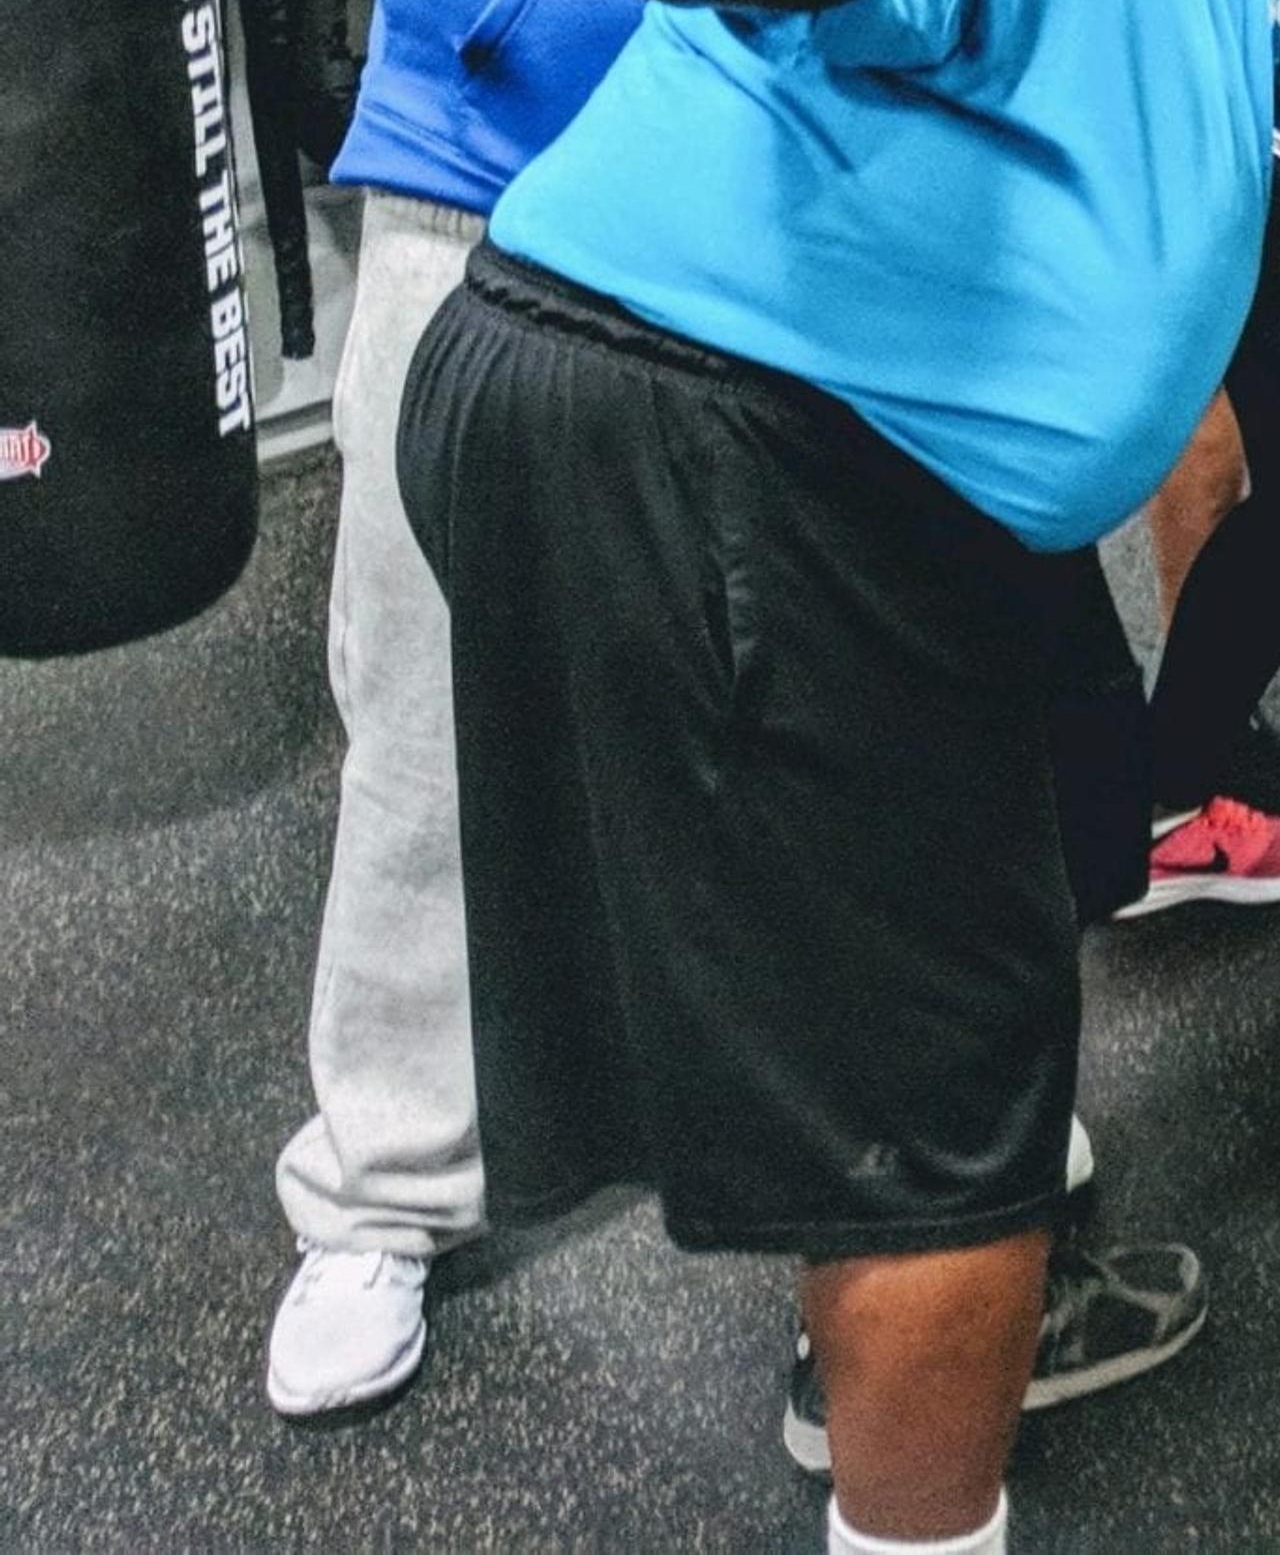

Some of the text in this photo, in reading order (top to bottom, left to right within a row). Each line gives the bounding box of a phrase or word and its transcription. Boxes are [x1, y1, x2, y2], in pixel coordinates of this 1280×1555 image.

[181, 4, 227, 178] STILL
[199, 168, 239, 293] THE
[211, 288, 251, 437] BEST
